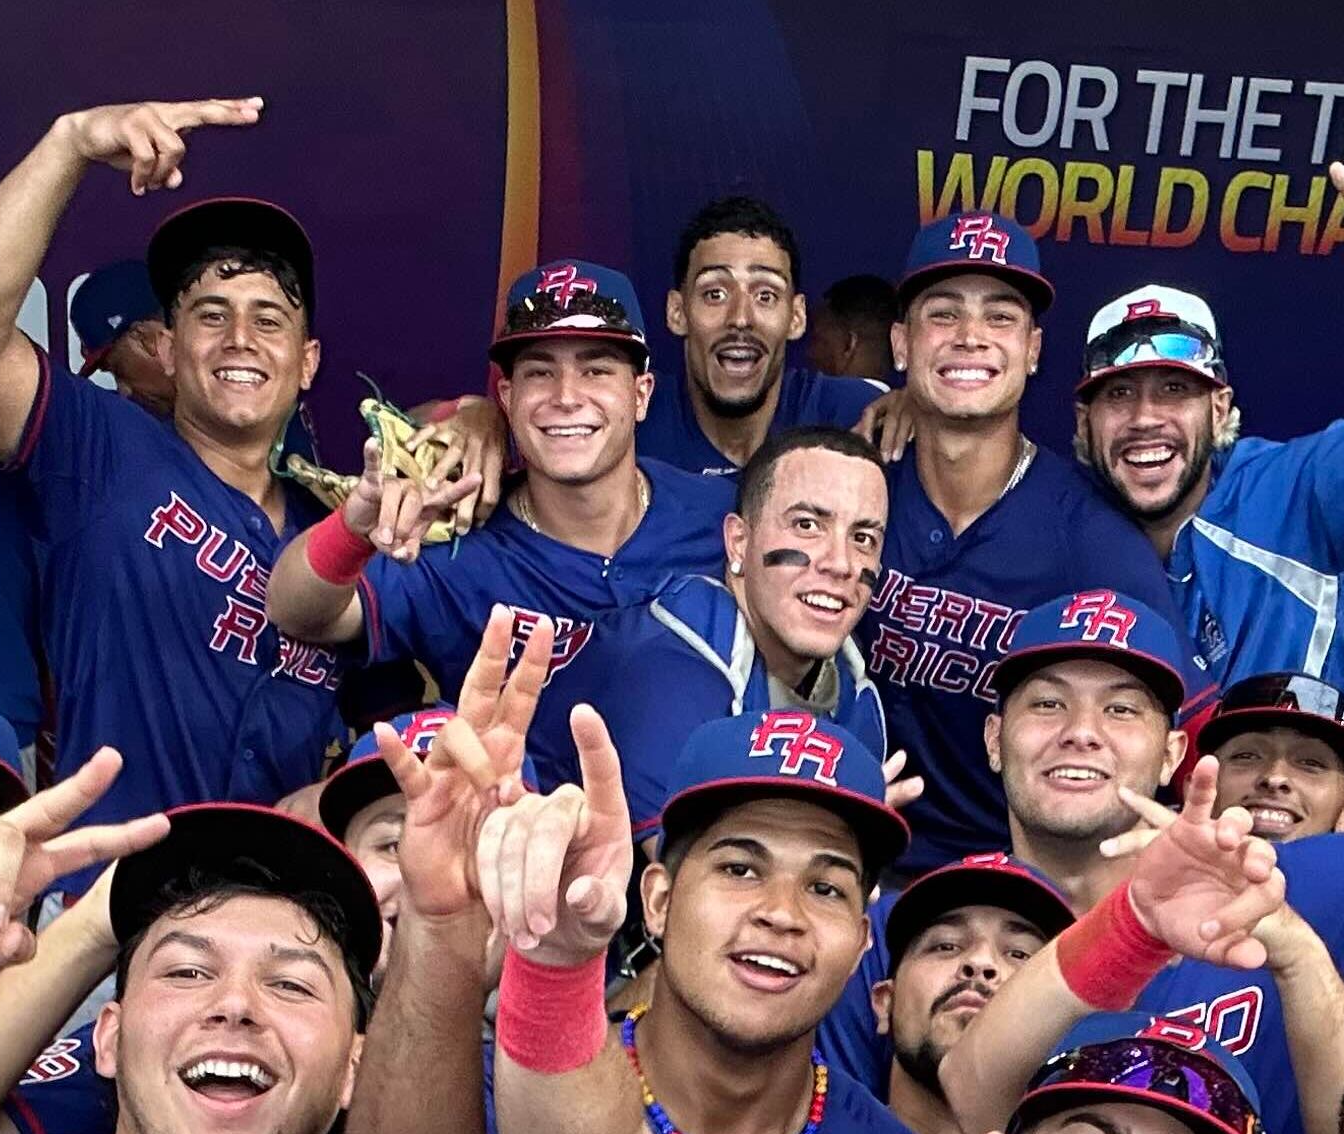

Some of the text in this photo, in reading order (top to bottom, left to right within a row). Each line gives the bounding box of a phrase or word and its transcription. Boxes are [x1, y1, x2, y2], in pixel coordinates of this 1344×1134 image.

[955, 55, 1120, 153] FOR
[1135, 68, 1294, 163] THE
[915, 149, 1210, 249] WORLD
[949, 209, 1011, 266] PR
[143, 489, 272, 604] PUE
[868, 568, 1030, 654] UERT
[1061, 588, 1138, 650] PR
[749, 710, 845, 787] PR
